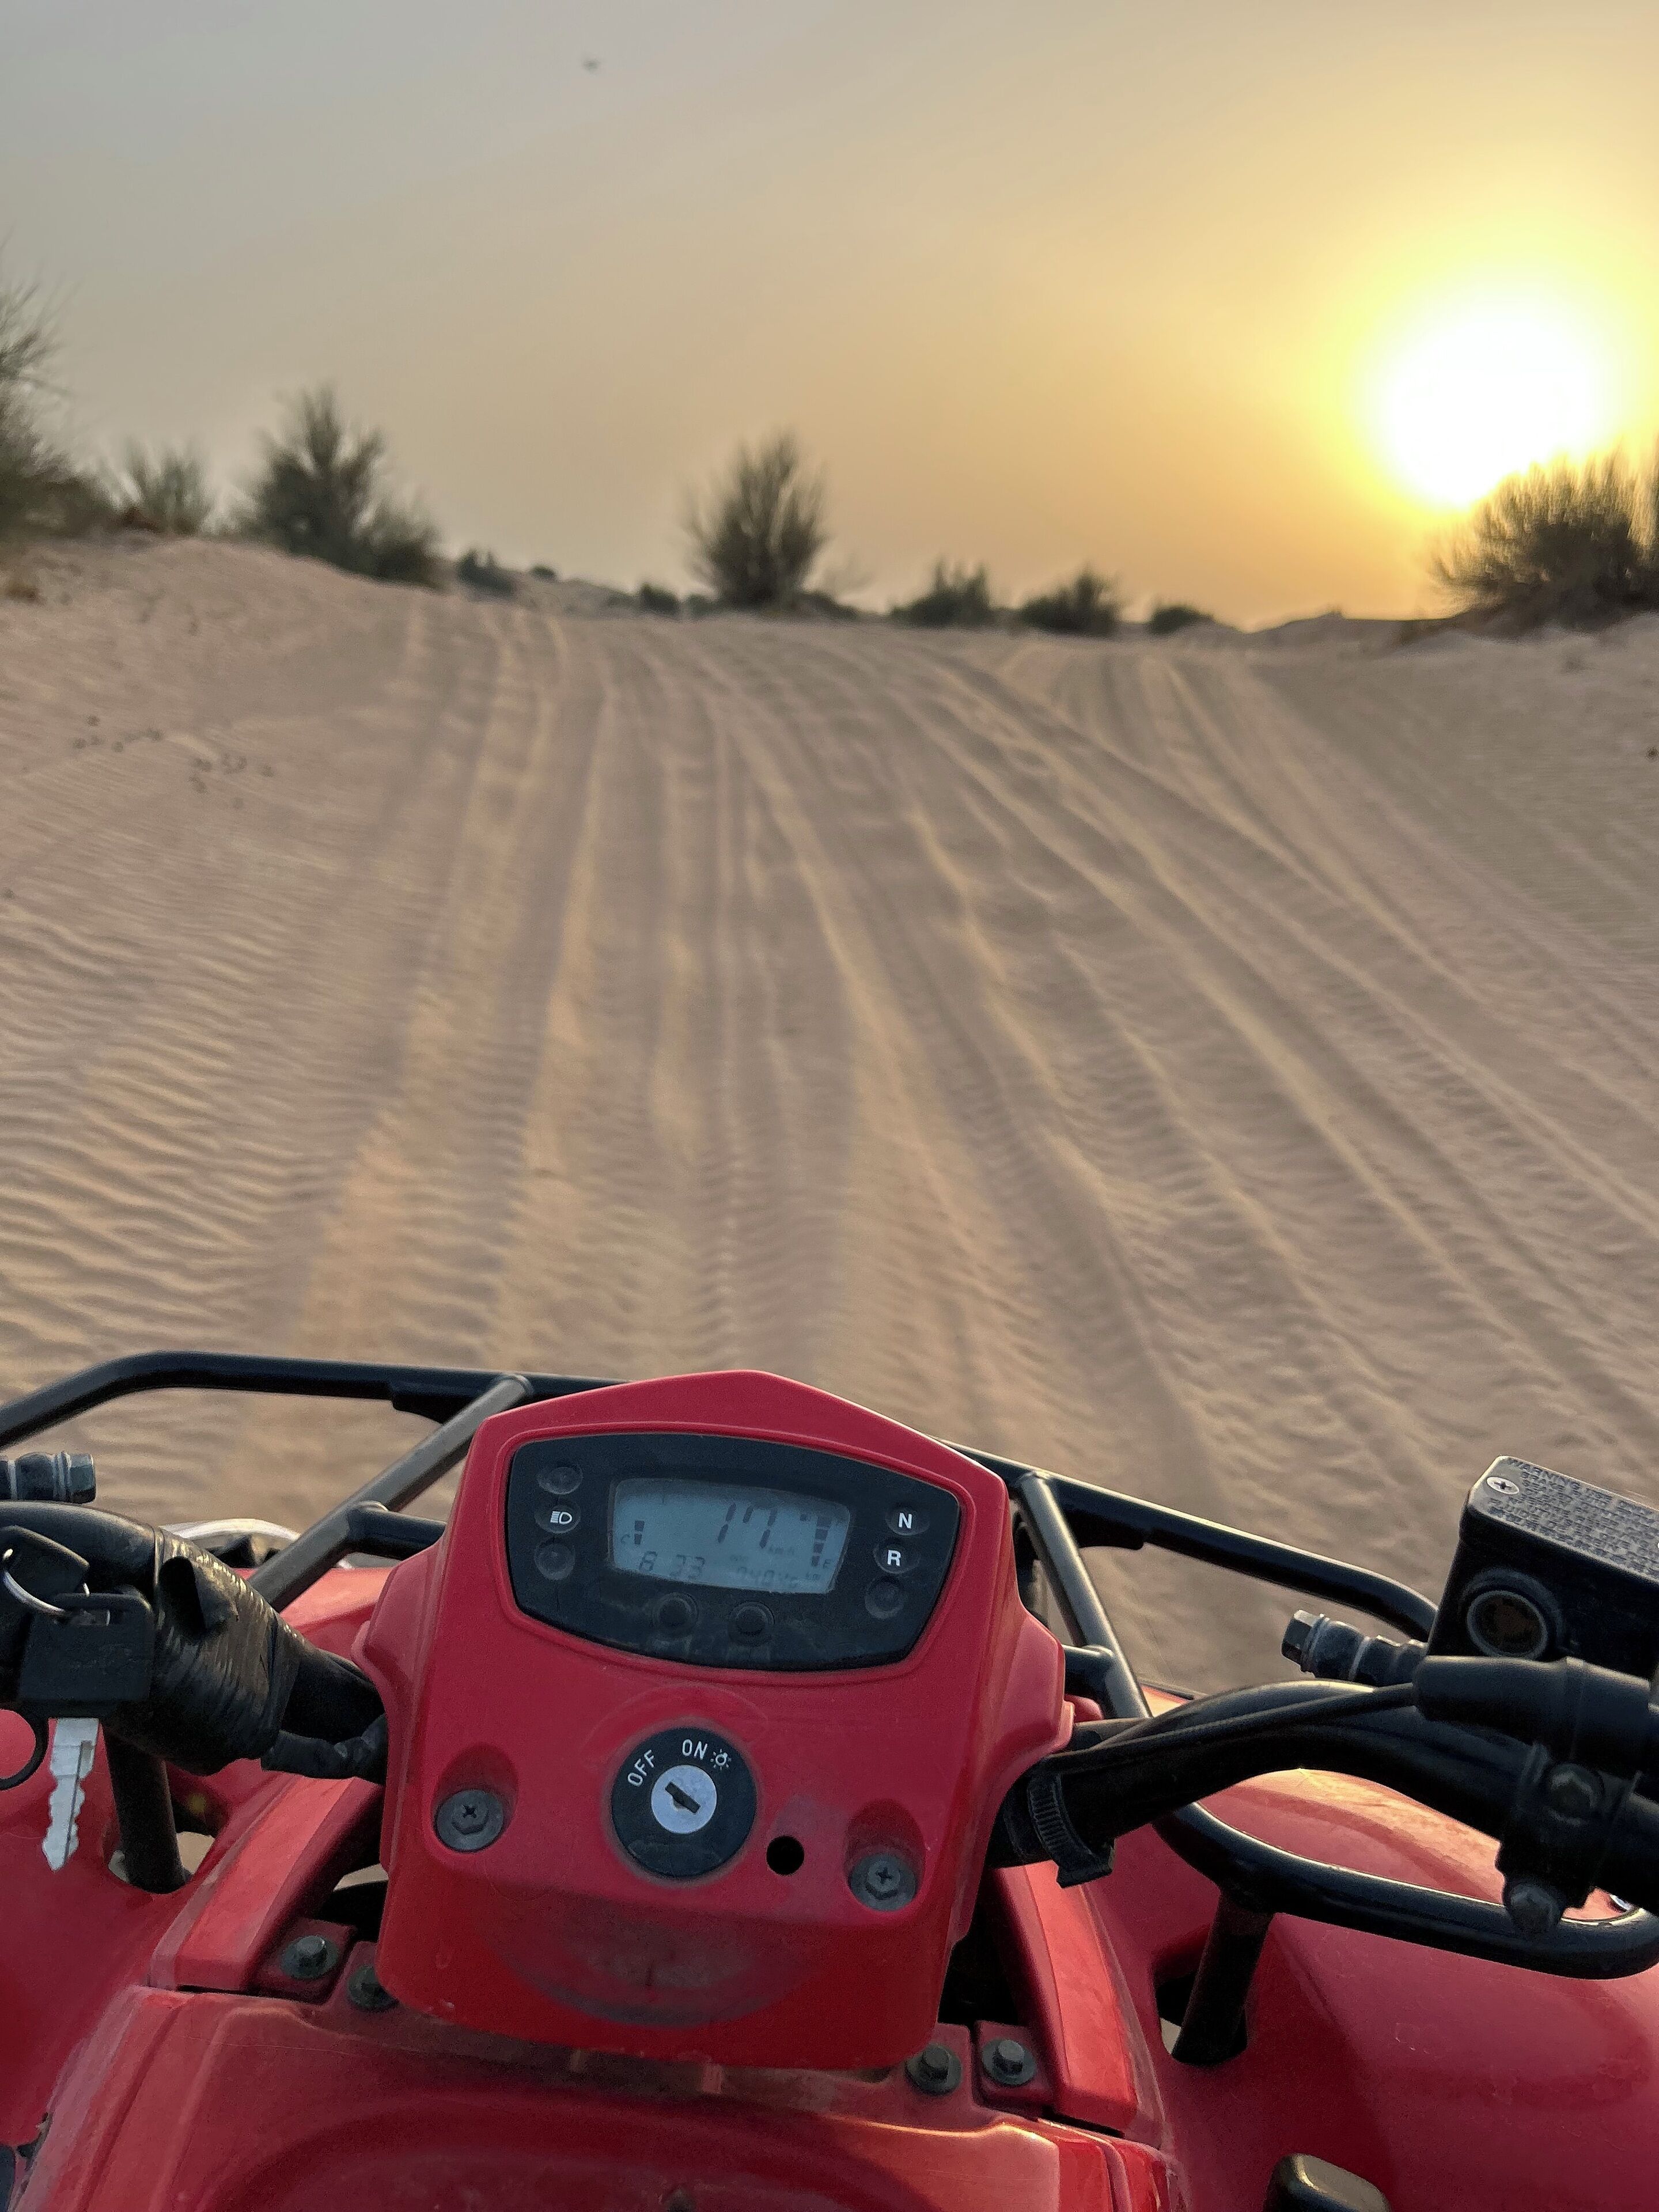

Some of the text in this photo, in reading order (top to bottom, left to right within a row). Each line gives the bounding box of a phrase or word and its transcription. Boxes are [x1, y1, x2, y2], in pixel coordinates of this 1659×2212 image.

[899, 1513, 912, 1529] N
[888, 1550, 902, 1567] R
[681, 1738, 708, 1760] ON
[627, 1749, 656, 1787] OFF
